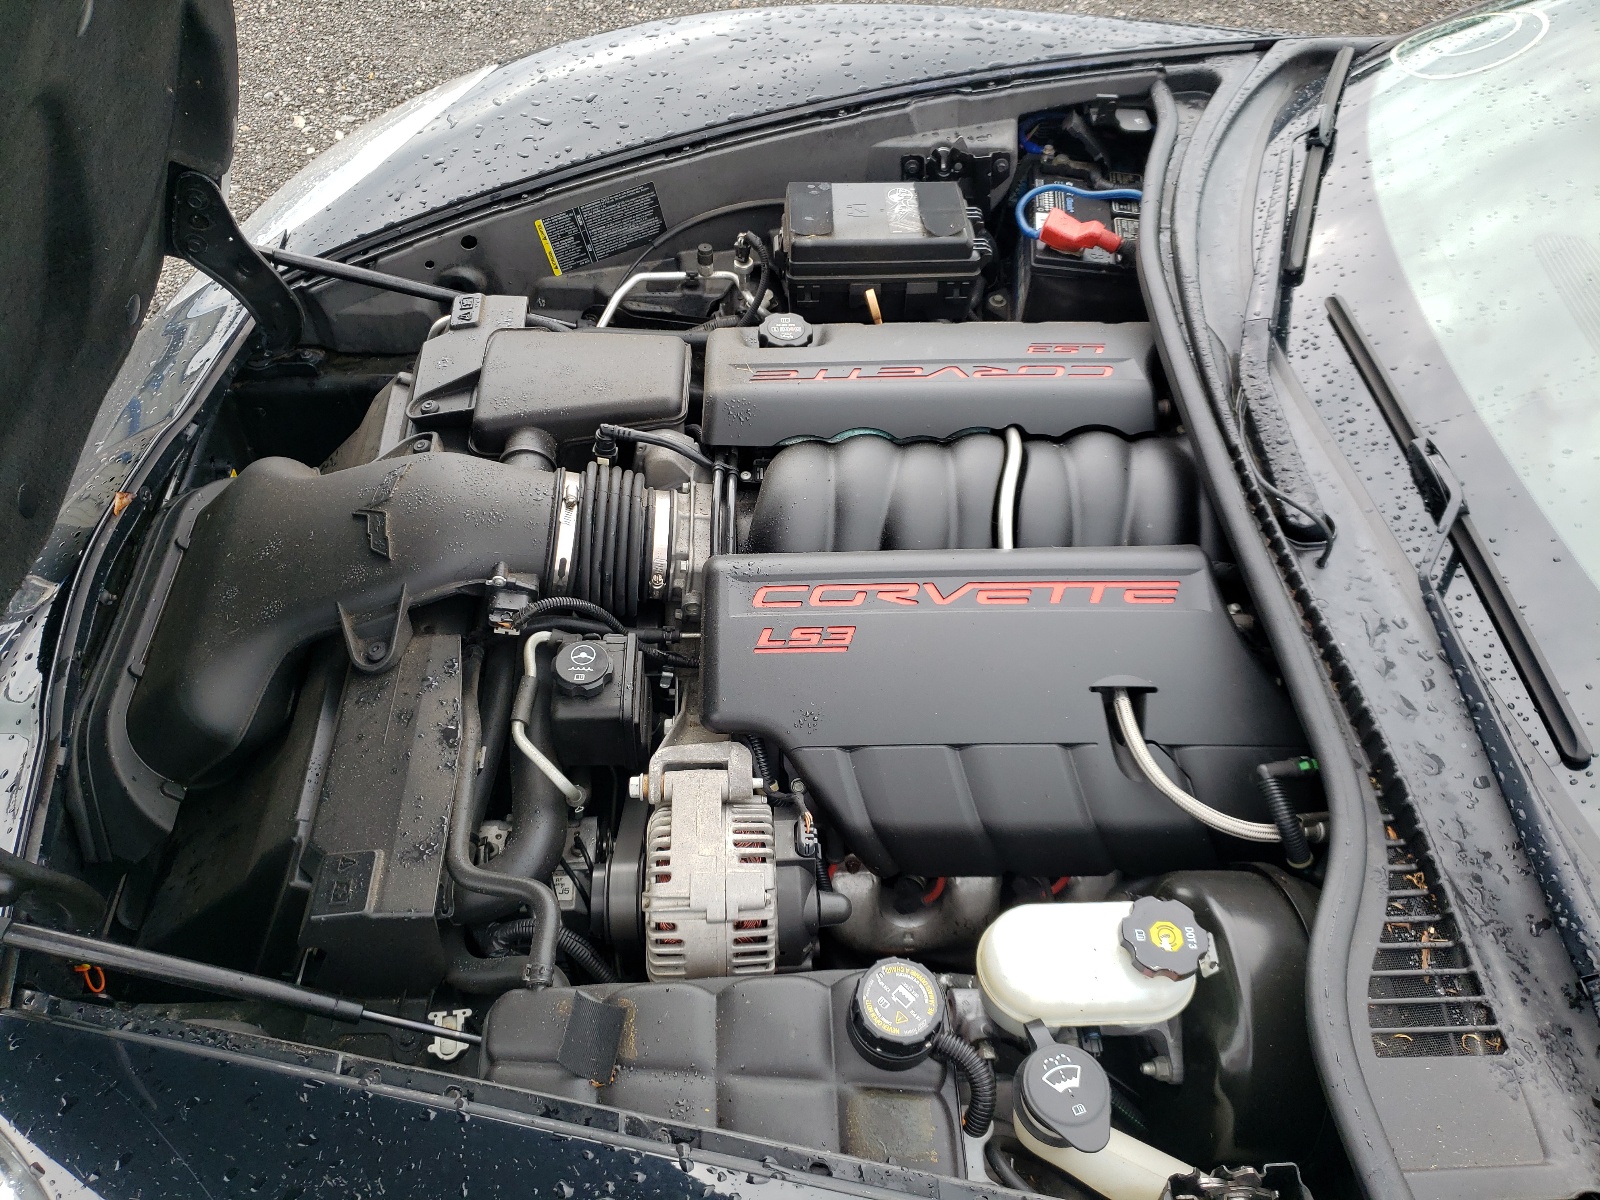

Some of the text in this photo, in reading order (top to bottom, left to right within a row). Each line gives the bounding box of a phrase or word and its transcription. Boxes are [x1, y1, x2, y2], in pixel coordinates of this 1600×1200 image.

[1027, 344, 1106, 354] LS3
[750, 364, 1114, 382] CORVETTE
[752, 580, 1181, 608] CORVETTE
[754, 625, 857, 649] LS3
[1185, 927, 1197, 943] DOT
[882, 1024, 900, 1034] NEVER
